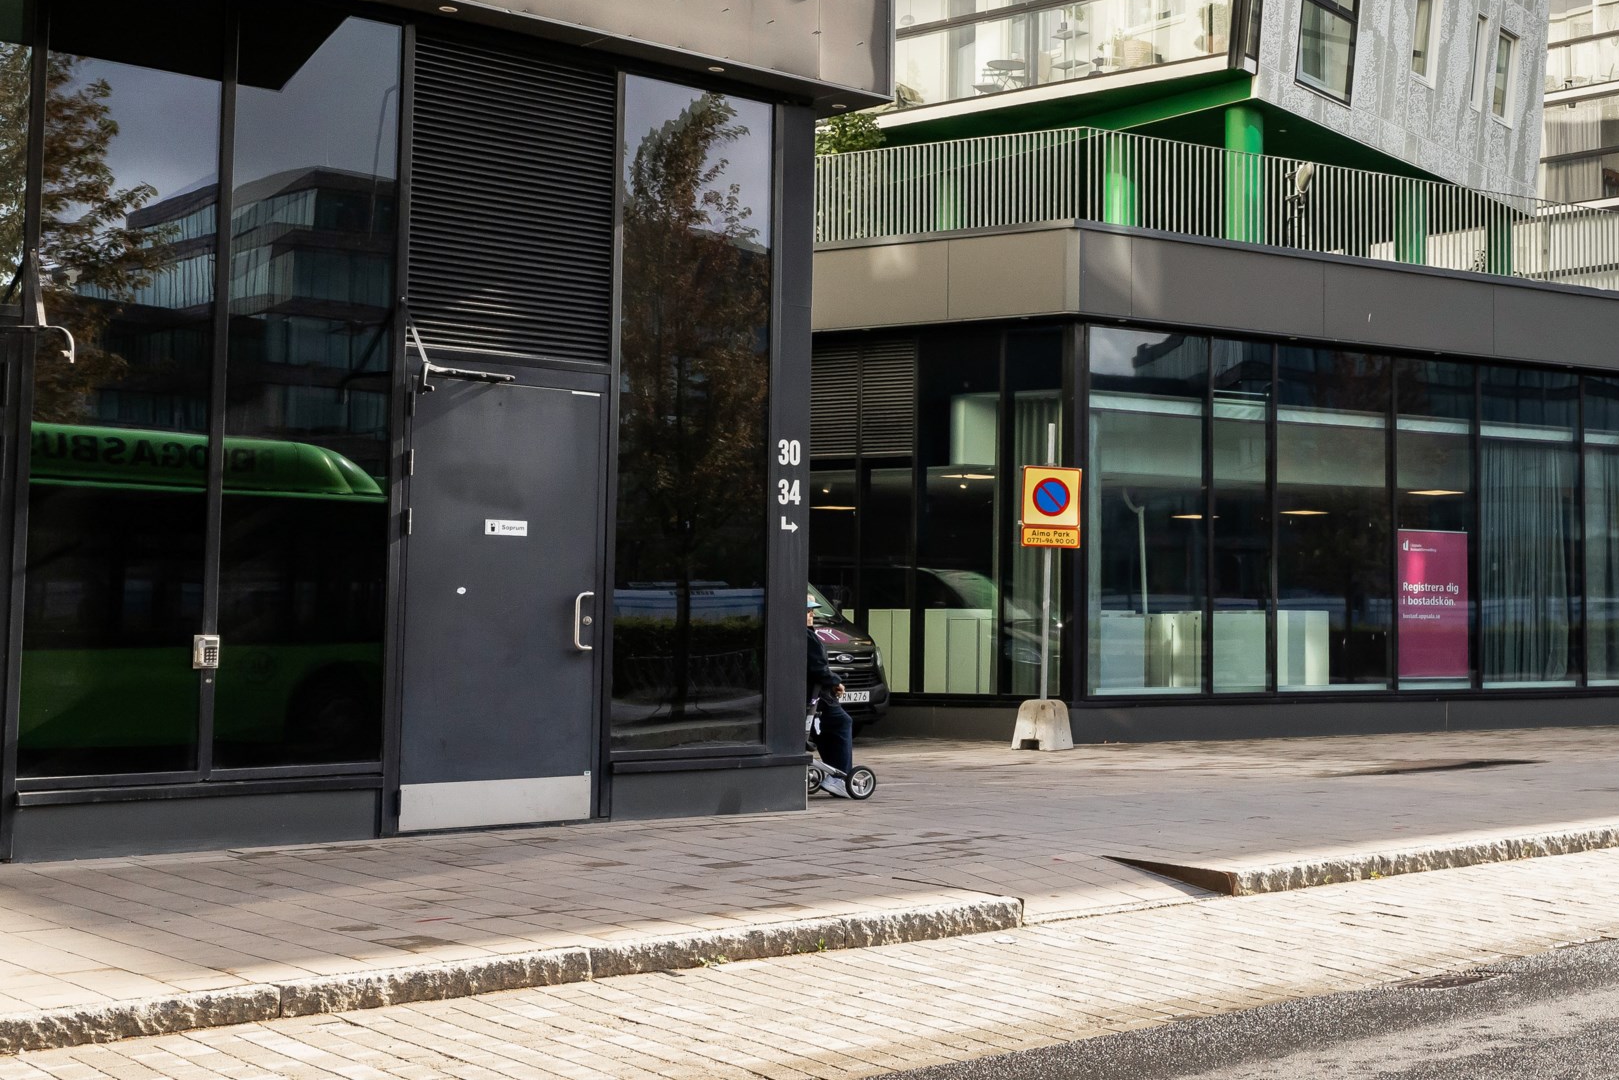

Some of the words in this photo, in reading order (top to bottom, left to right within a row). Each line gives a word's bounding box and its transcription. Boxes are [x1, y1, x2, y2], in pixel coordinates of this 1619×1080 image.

[778, 439, 801, 466] 30
[778, 479, 801, 506] 34
[501, 524, 525, 532] Soprum
[1402, 582, 1445, 594] Registrera
[1446, 583, 1459, 595] dig
[1402, 595, 1406, 605] i
[1407, 595, 1456, 606] bostadskön.
[853, 692, 867, 702] 276
